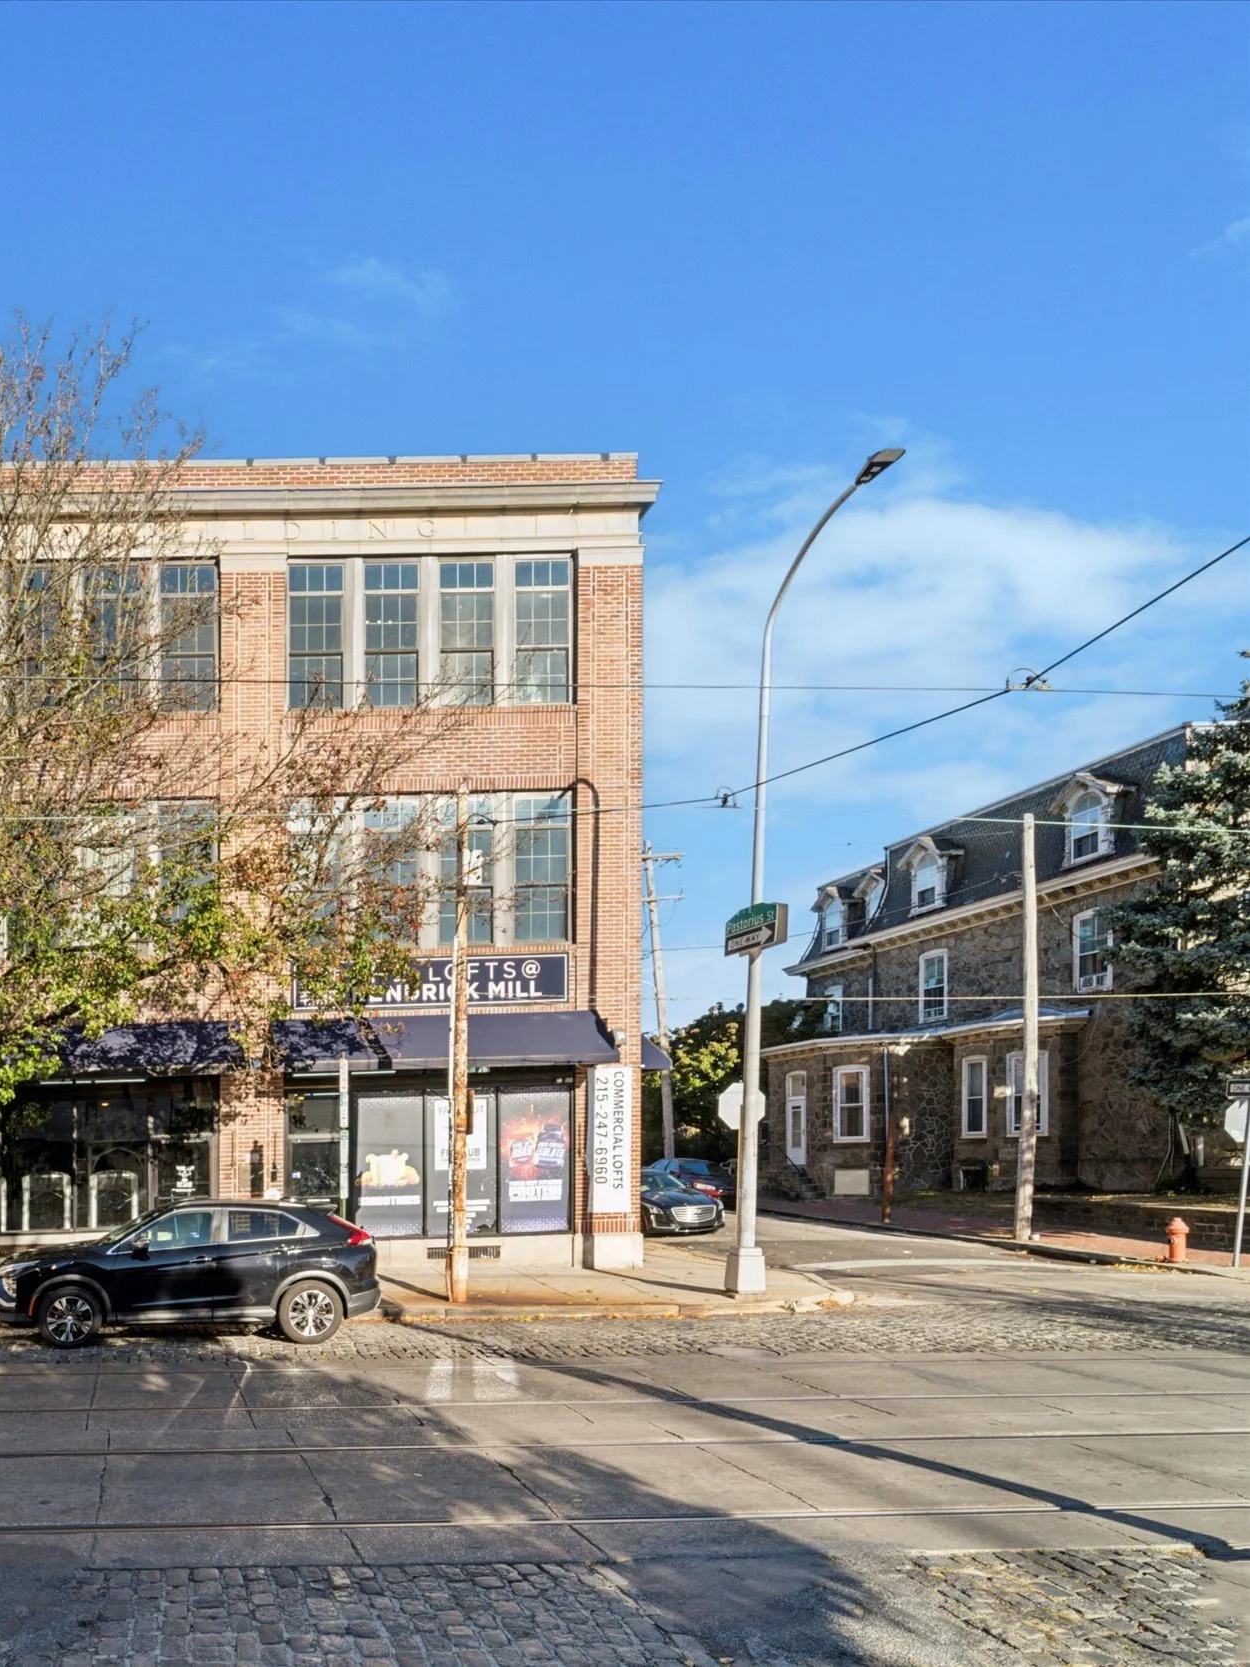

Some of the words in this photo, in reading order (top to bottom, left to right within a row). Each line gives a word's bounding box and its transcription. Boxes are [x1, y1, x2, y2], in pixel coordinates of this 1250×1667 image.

[726, 912, 764, 934] Pastorius
[766, 910, 775, 921] St
[731, 937, 745, 949] ONE
[745, 932, 760, 944] WAY
[488, 980, 542, 999] MILL
[612, 1070, 625, 1152] COMMERCIAL
[594, 1077, 609, 1185] 215-247-6960
[612, 1153, 624, 1190] LOFTS
